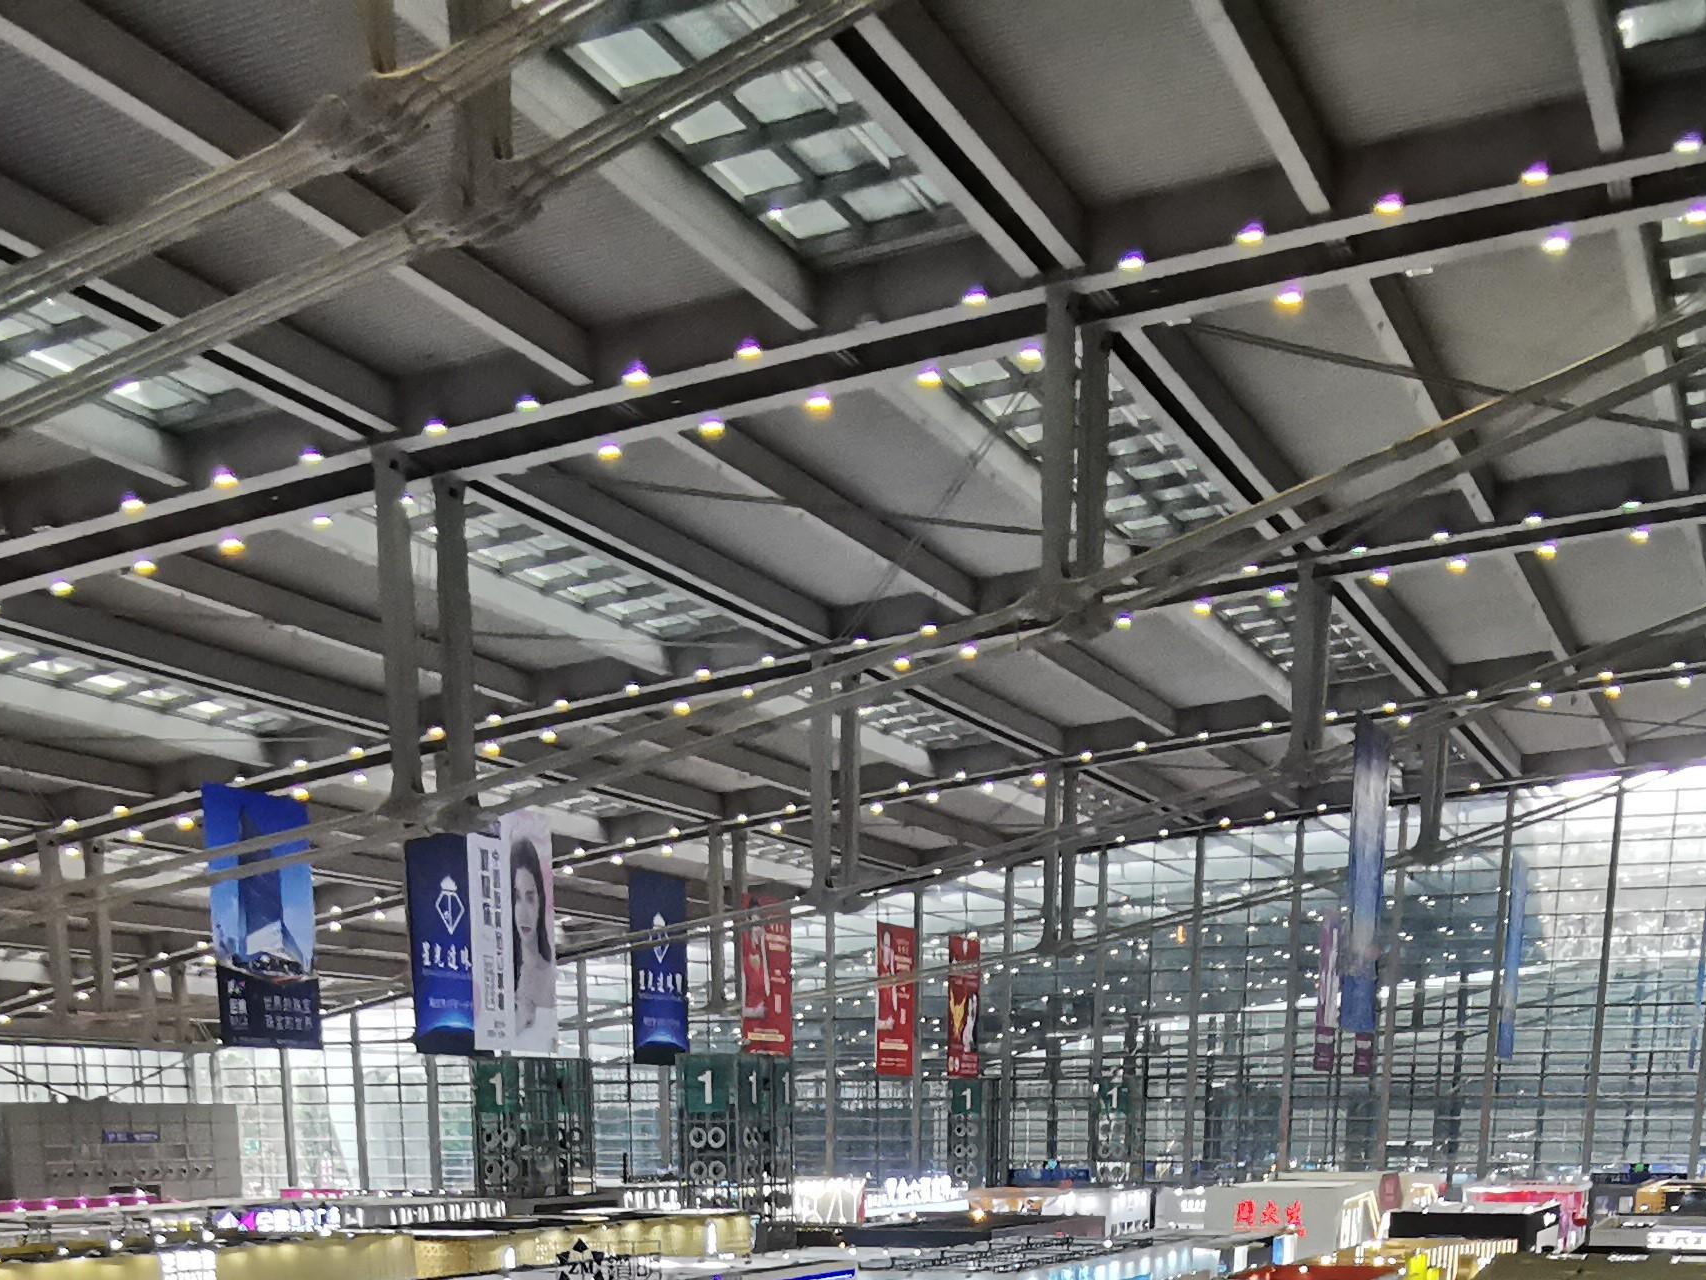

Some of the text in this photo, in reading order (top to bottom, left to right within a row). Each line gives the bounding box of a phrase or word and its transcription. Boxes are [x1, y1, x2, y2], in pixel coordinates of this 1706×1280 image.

[489, 1072, 504, 1106] 1
[696, 1070, 713, 1105] 1
[959, 1087, 973, 1111] 1
